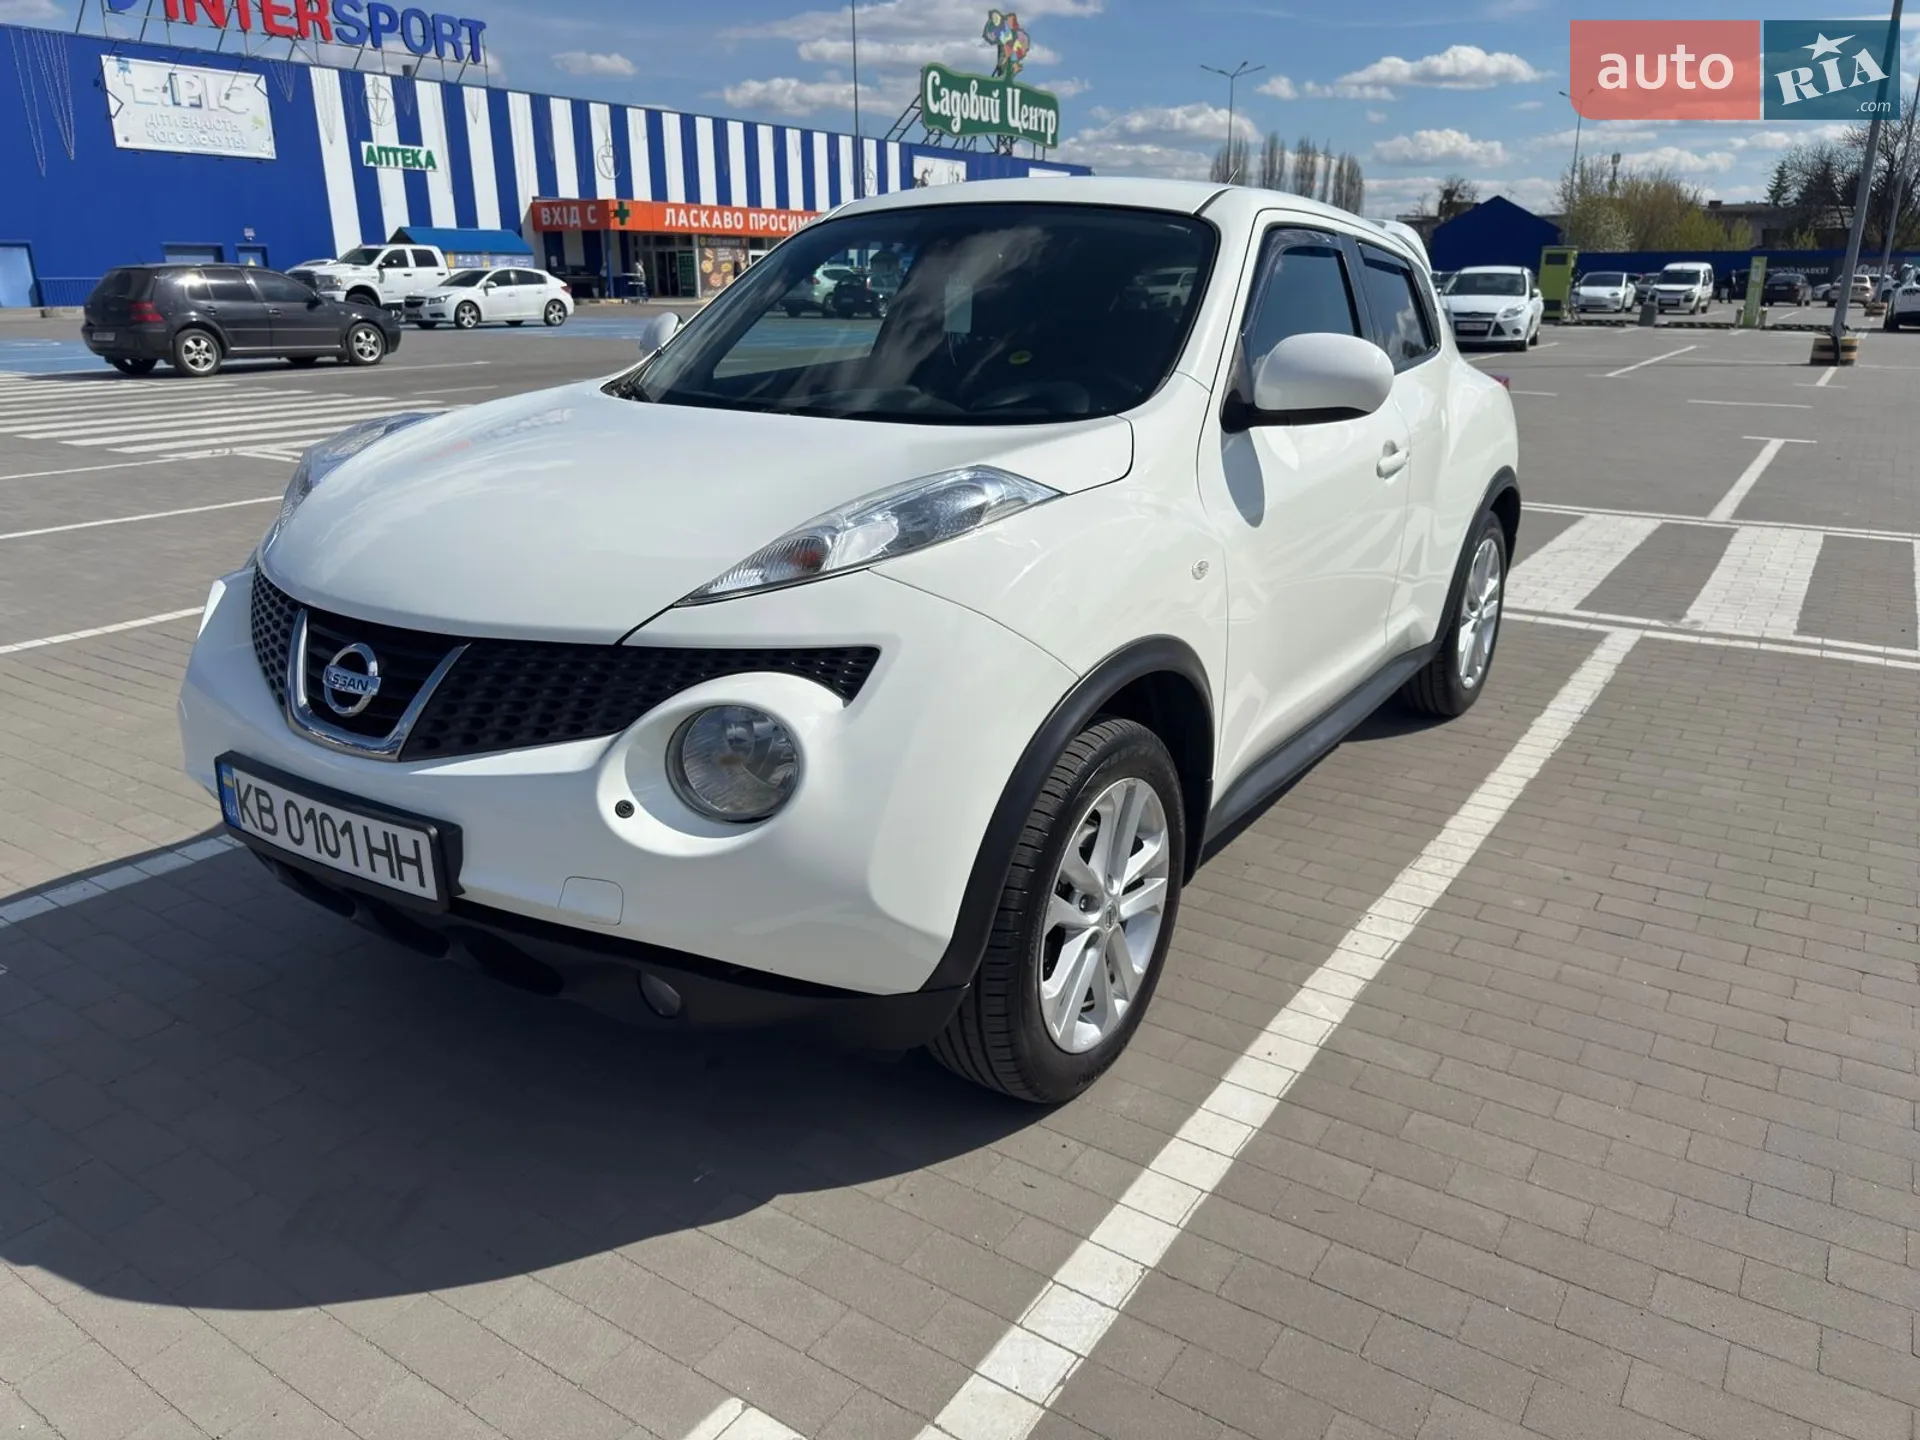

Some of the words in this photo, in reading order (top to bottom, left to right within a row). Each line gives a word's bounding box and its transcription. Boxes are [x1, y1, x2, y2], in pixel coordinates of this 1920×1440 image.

[926, 70, 1001, 133] Садовий
[1006, 87, 1057, 144] Центр
[365, 145, 437, 170] АПТЕКА
[541, 205, 582, 228] ВХІД
[586, 204, 598, 224] С
[664, 207, 744, 231] ЛАСКАВО
[236, 778, 278, 836] KB
[284, 799, 359, 868] 0101
[363, 825, 426, 888] HH
